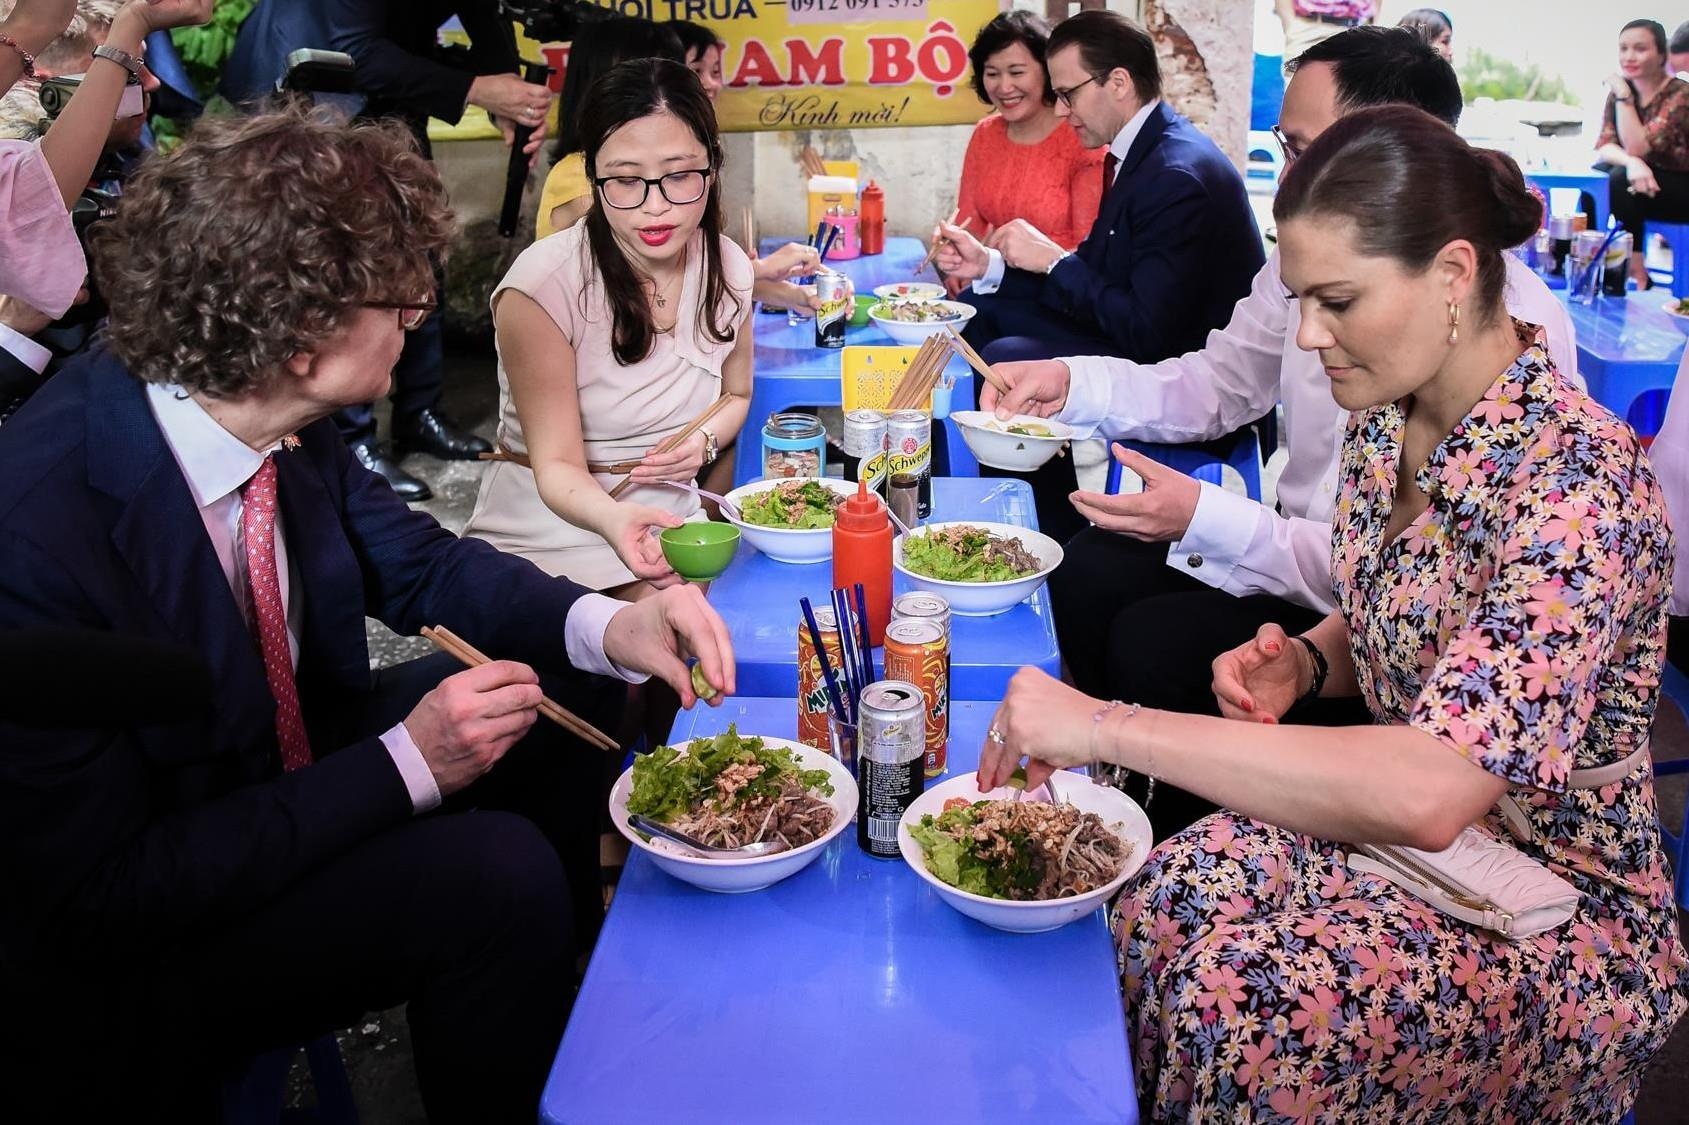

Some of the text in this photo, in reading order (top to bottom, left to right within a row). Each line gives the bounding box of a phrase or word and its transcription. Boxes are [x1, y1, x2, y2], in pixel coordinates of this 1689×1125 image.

[718, 20, 967, 96] AM BỘ
[759, 95, 840, 126] Kính
